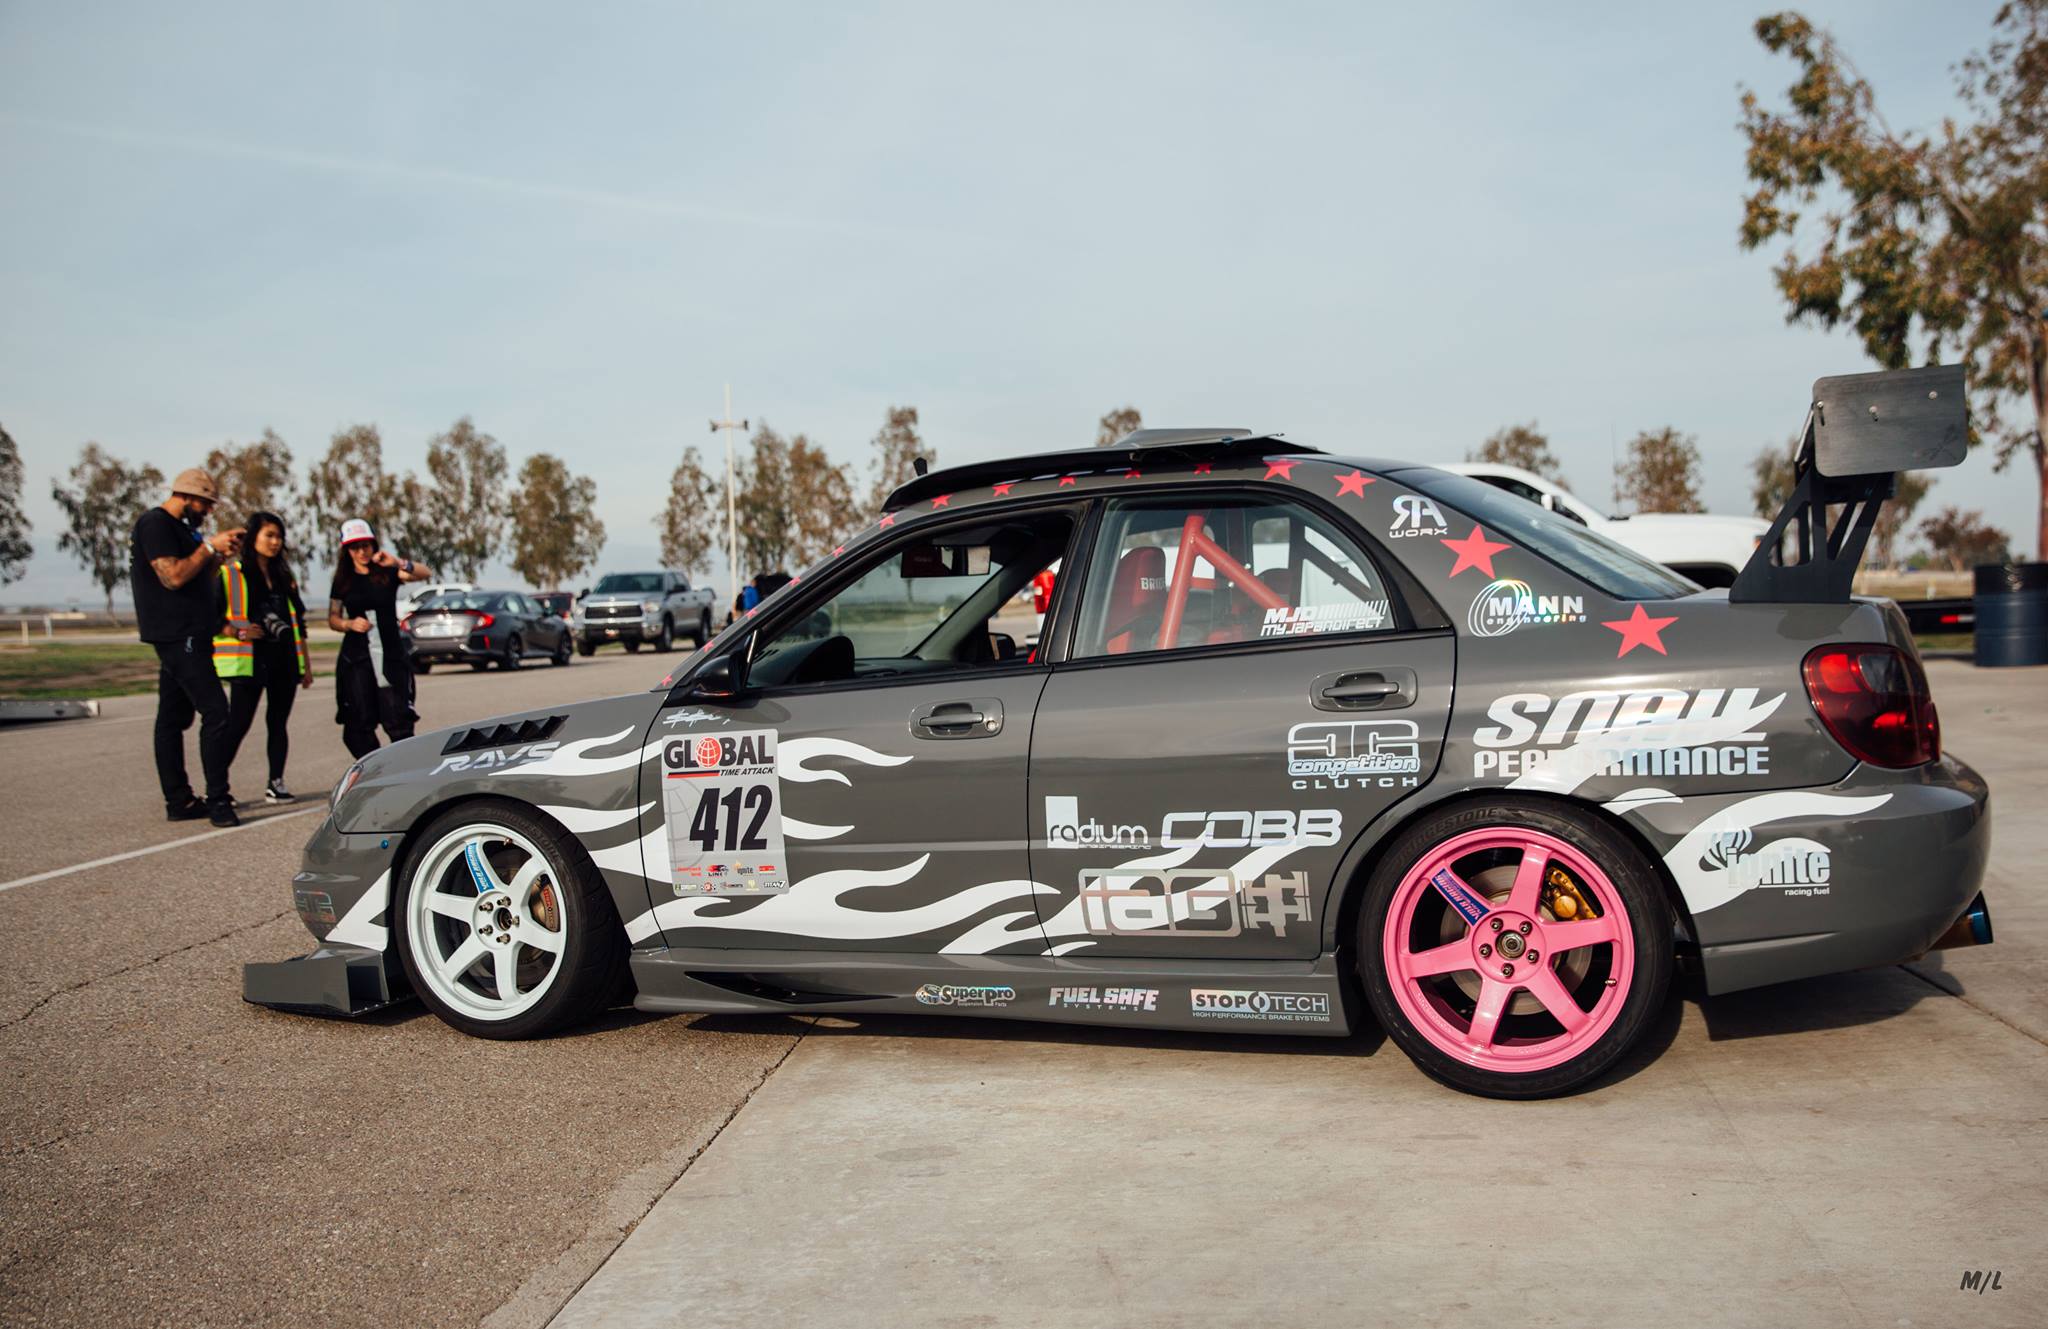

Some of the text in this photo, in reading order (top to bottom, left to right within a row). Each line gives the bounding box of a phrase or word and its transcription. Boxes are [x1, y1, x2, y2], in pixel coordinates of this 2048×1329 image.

[1389, 527, 1448, 538] WORX
[1489, 595, 1584, 617] MANN
[663, 735, 775, 769] GLOBAL
[1473, 746, 1770, 778] PERRMANCE
[720, 766, 775, 776] TIME ATTACK
[1289, 754, 1420, 778] competition
[1292, 776, 1419, 790] CLUTCH
[689, 784, 773, 852] 412
[1160, 808, 1343, 848] COBB
[1049, 817, 1150, 843] radium
[1784, 887, 1830, 896] racing fuel
[1049, 987, 1159, 1011] FUEL SAFE
[1063, 1003, 1138, 1012] SYSTEMS
[1212, 1012, 1267, 1020] PERFORMANCE
[1294, 1014, 1330, 1022] SYSTEMS
